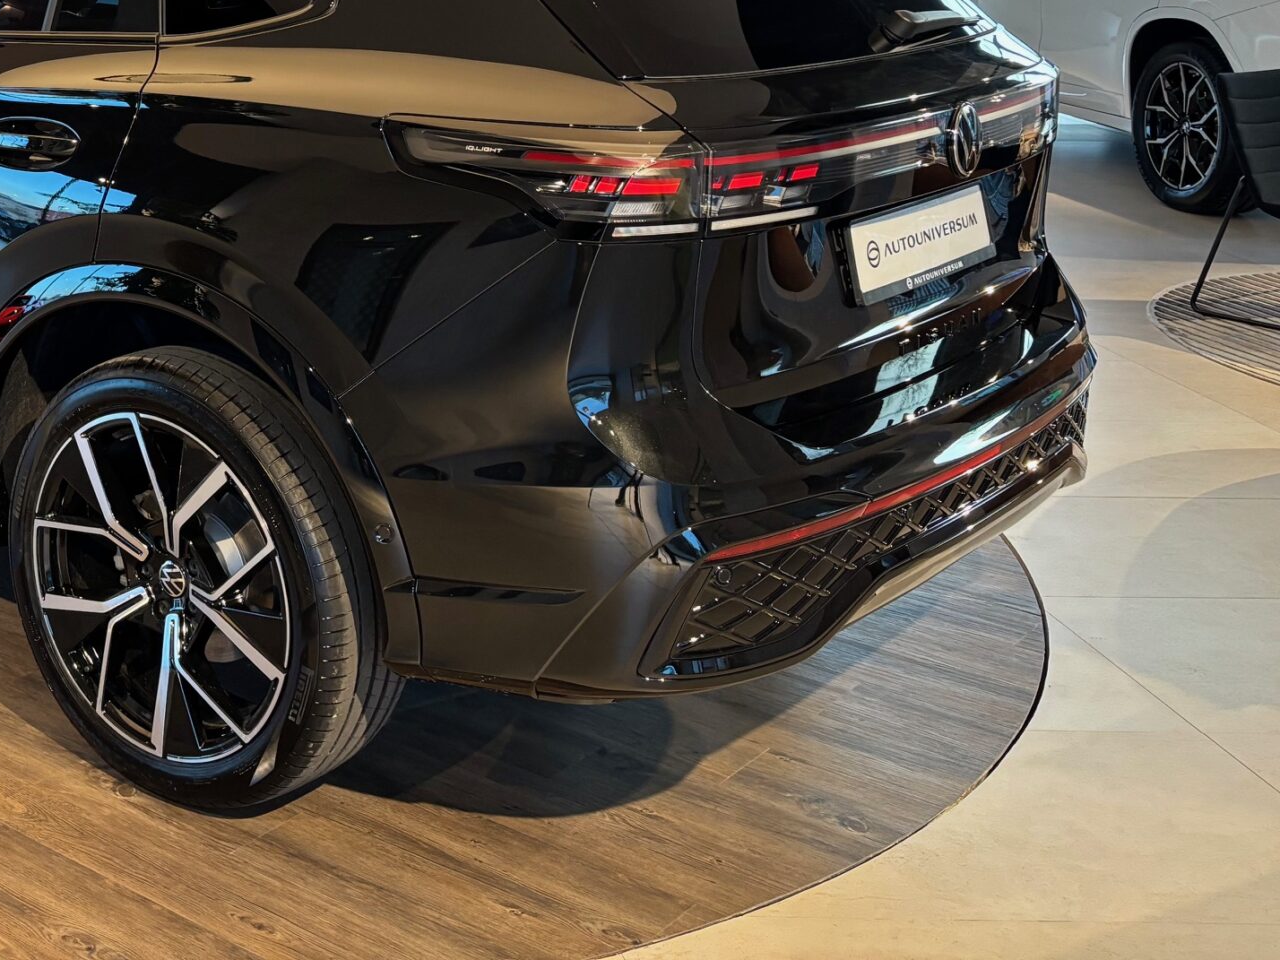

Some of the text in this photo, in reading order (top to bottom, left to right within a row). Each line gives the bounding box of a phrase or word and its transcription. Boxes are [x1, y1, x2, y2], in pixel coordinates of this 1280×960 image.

[465, 144, 504, 154] IQ.LIGHT
[884, 212, 978, 258] AUTOUNIVERSUM
[913, 260, 964, 285] AUTOUNIVERSUM
